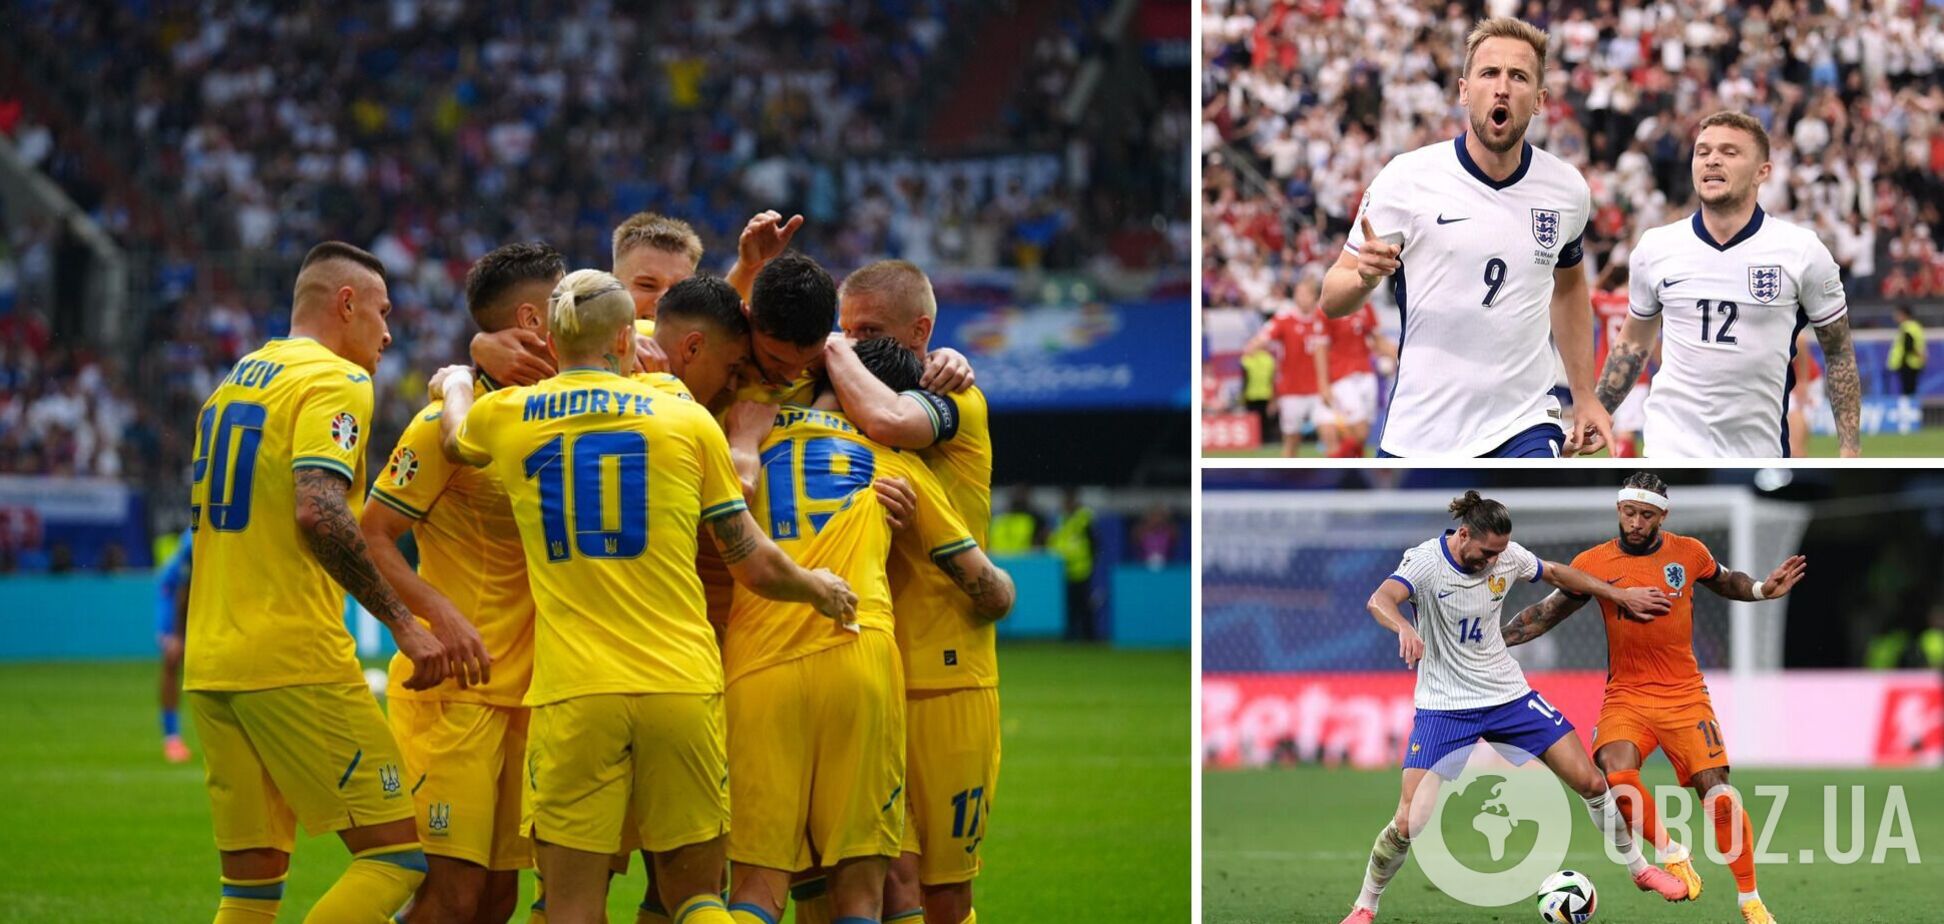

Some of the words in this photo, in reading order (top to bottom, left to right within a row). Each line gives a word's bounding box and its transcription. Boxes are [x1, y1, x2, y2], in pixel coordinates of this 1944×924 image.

[1482, 258, 1508, 308] 9
[1696, 298, 1738, 345] 12
[224, 358, 285, 389] KOV
[522, 388, 655, 422] MUDRYK
[522, 430, 649, 564] 10
[759, 436, 876, 541] 19
[1458, 616, 1483, 644] 14
[951, 786, 984, 839] 17
